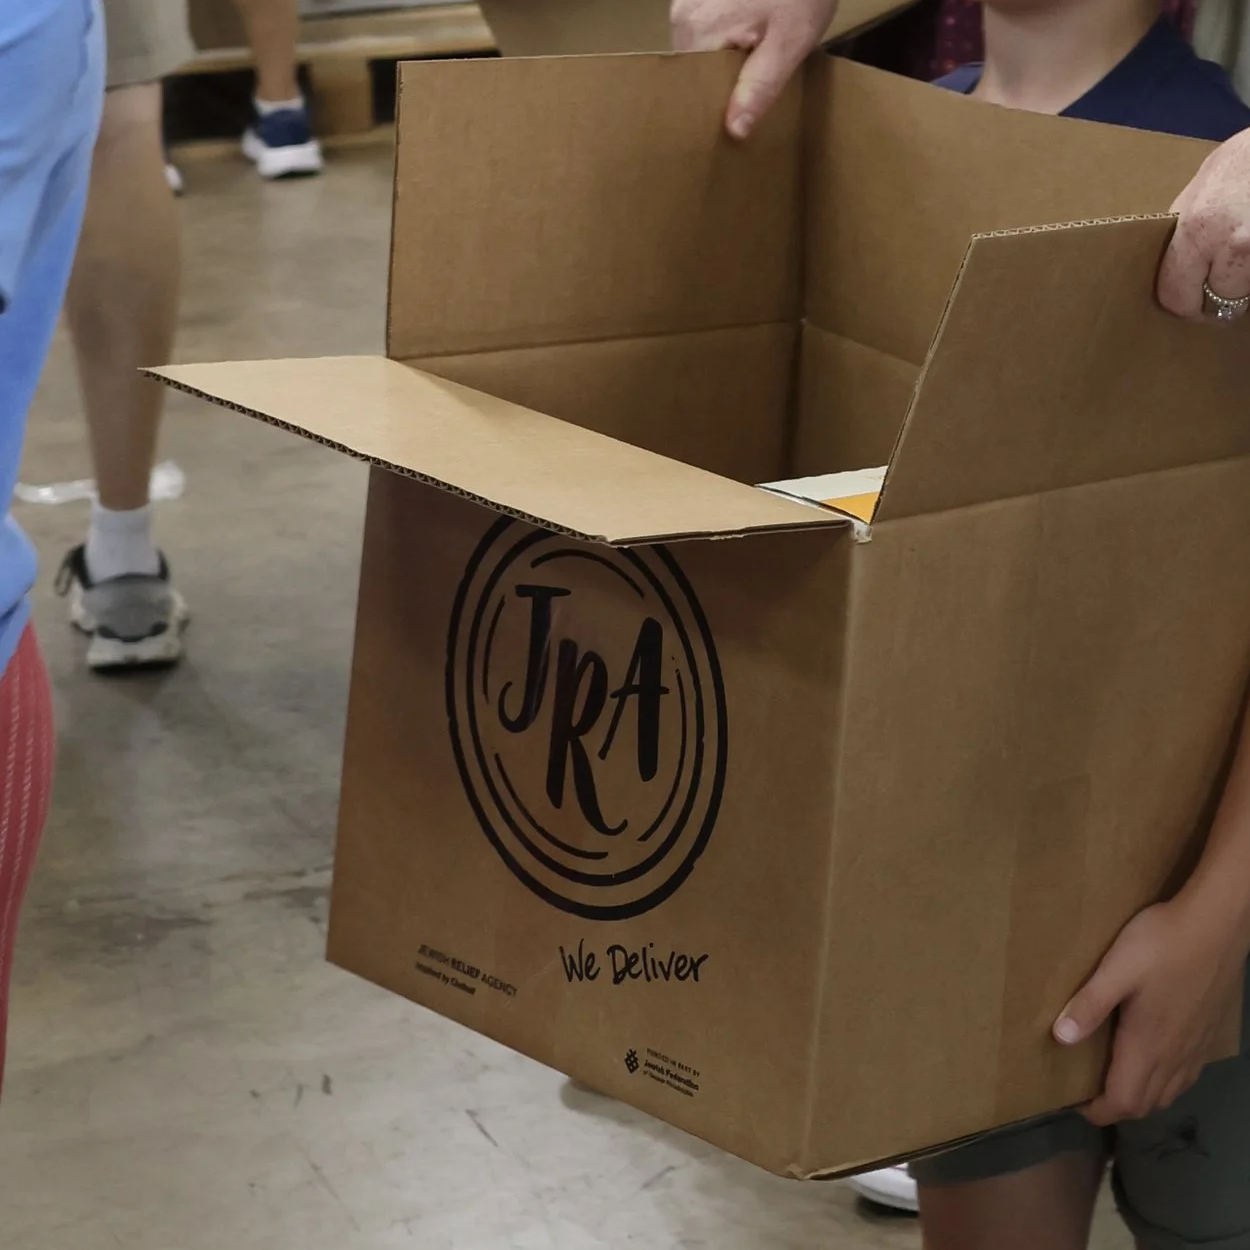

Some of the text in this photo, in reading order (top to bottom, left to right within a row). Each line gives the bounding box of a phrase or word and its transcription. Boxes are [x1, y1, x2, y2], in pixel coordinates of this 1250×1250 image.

[498, 584, 669, 836] JRA
[481, 973, 518, 997] AGENCY
[559, 938, 709, 985] We Deliver
